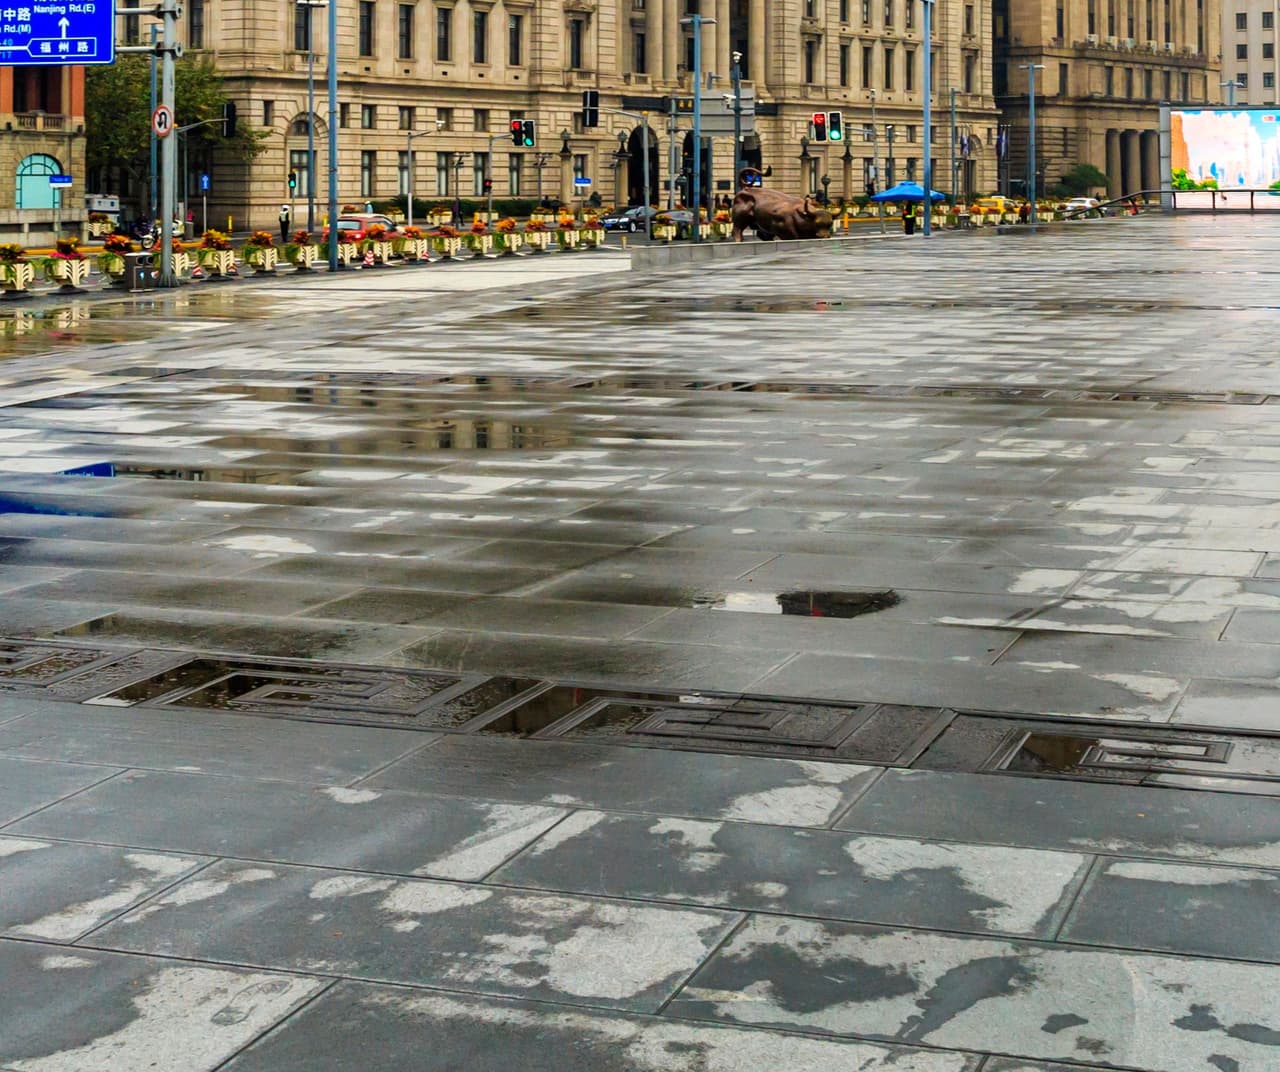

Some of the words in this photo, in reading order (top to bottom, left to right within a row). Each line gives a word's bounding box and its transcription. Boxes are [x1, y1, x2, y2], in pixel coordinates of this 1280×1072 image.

[33, 4, 66, 15] Nanjing
[69, 3, 96, 14] Rd.(E)
[3, 23, 32, 34] Rd.(M)
[40, 42, 89, 53] 福州路
